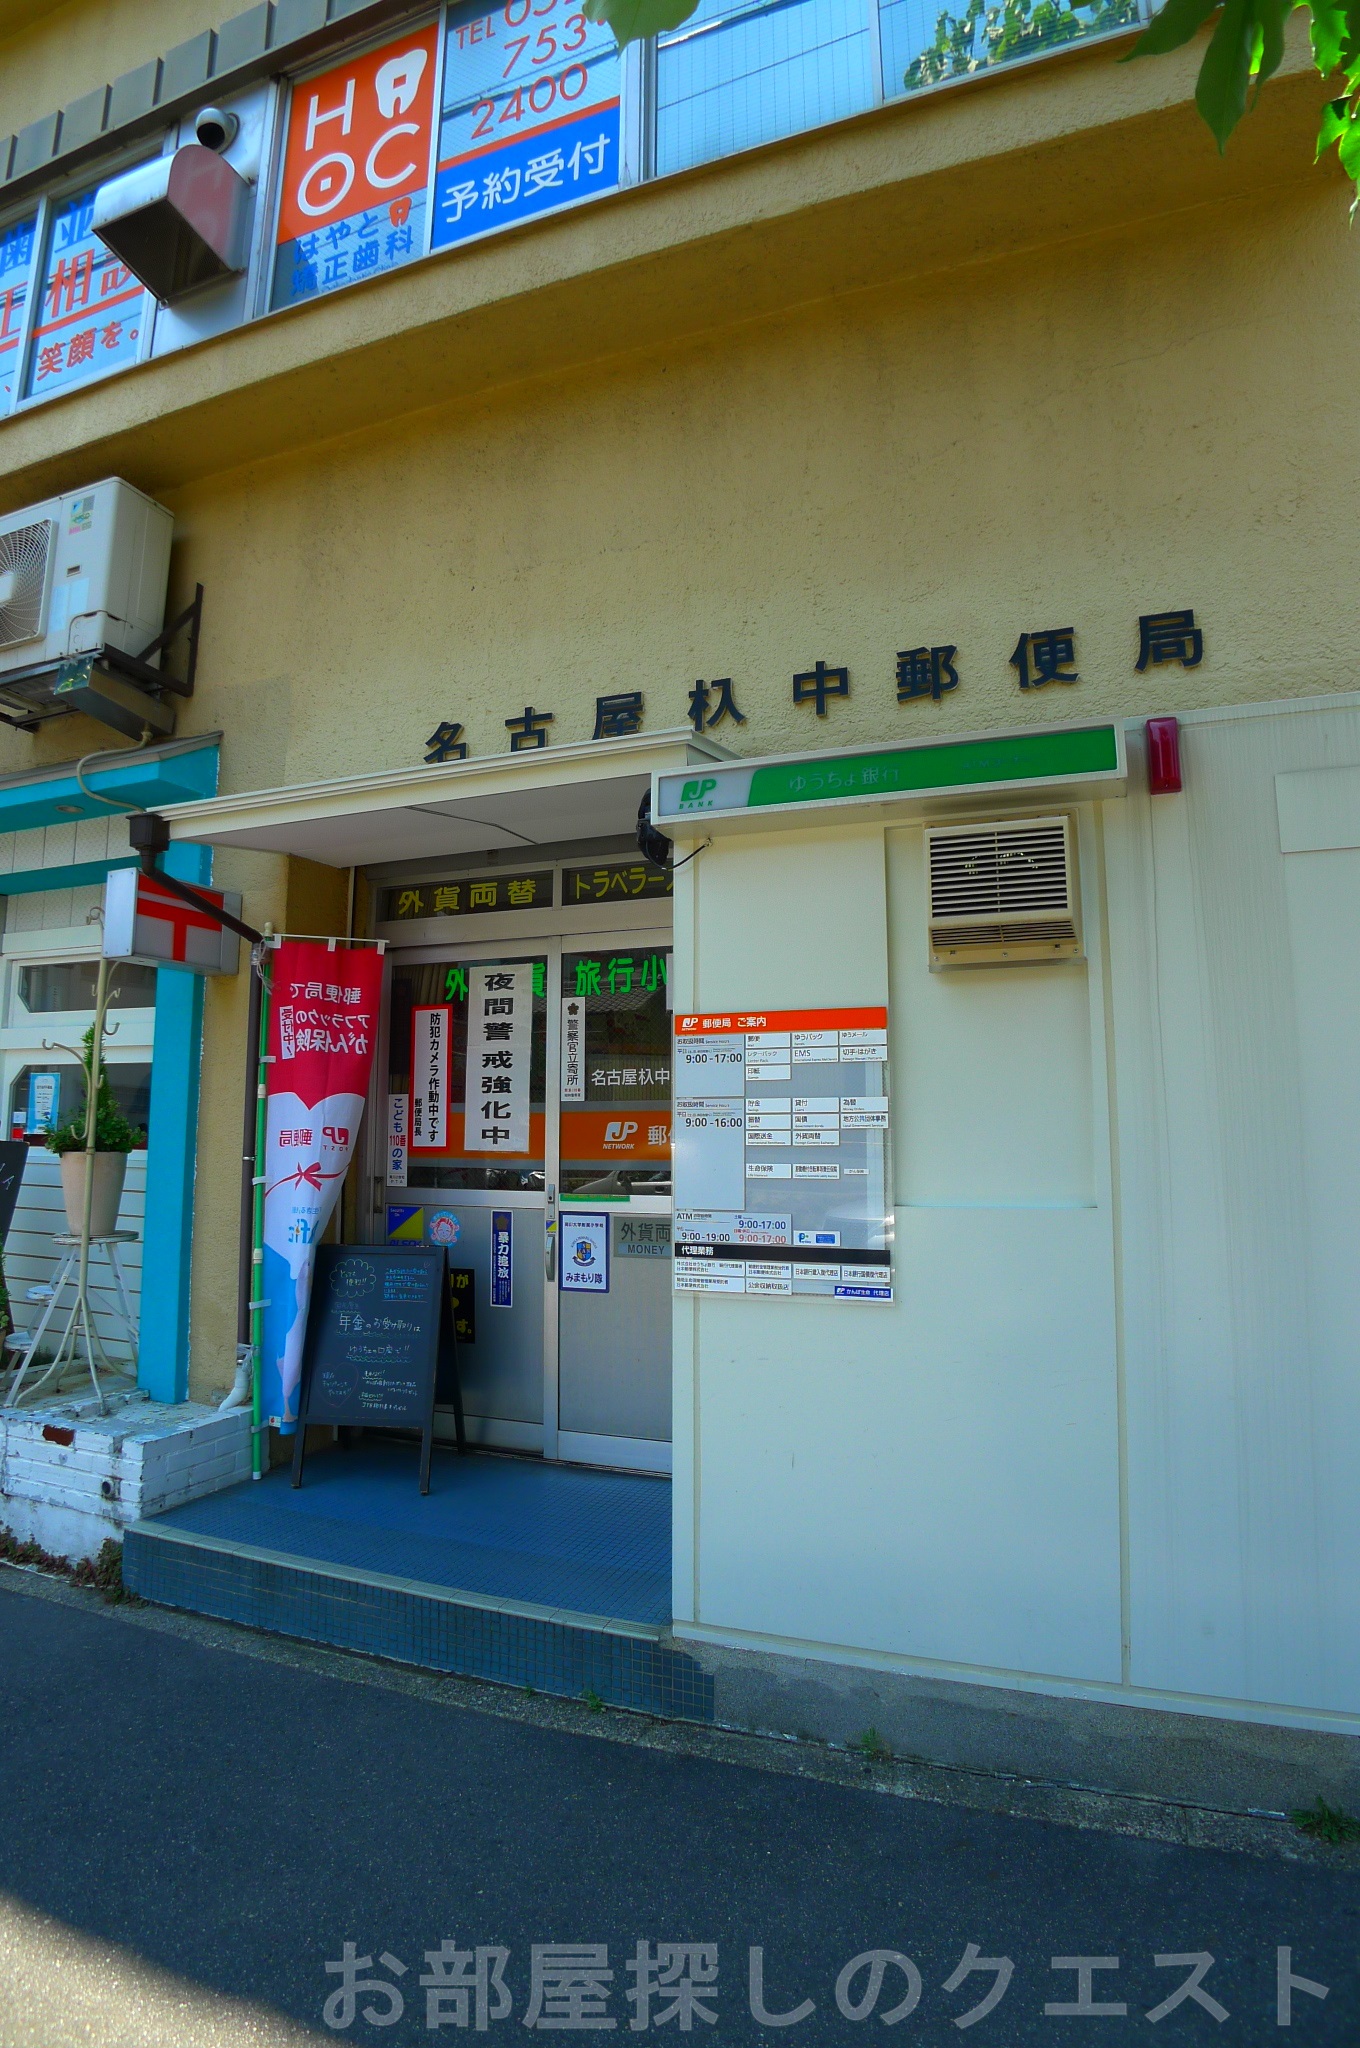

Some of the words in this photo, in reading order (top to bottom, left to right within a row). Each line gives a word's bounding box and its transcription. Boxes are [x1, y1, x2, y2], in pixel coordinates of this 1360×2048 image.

[456, 16, 496, 50] TEL
[471, 63, 588, 140] 2400
[442, 134, 611, 223] 予約受付
[293, 212, 378, 265] はやと
[290, 225, 413, 297] 矯正歯科
[37, 321, 139, 381] 笑顔を。
[423, 609, 1203, 765] 名古屋杁中郵便局
[789, 767, 899, 792] ゆうちょ銀行
[679, 800, 714, 810] BANK
[398, 879, 536, 914] 外貨両替
[576, 866, 673, 899] トラベラー
[702, 1017, 732, 1029] 郵便局
[737, 1016, 767, 1028] ご案内
[794, 1032, 824, 1041] ゆうパック
[481, 972, 515, 1145] 夜間警戒強化中
[567, 1019, 579, 1085] 警察官立寄所
[794, 1049, 811, 1058] EMS
[428, 1013, 441, 1143] 防犯カメラ作動中です
[591, 1067, 670, 1086] 名古屋杁中
[414, 1098, 423, 1137] 郵便局長
[389, 1098, 406, 1171] こども110番の家
[647, 1125, 671, 1146] 郵
[676, 1213, 693, 1221] ATM
[738, 1220, 787, 1230] 9:00-17:00
[627, 1244, 665, 1255] MONEY
[681, 1232, 731, 1242] 9:00-19:00
[681, 1245, 714, 1256] 代理業務
[738, 1234, 787, 1244] 9:00-17:00
[565, 1272, 603, 1284] みまもり隊
